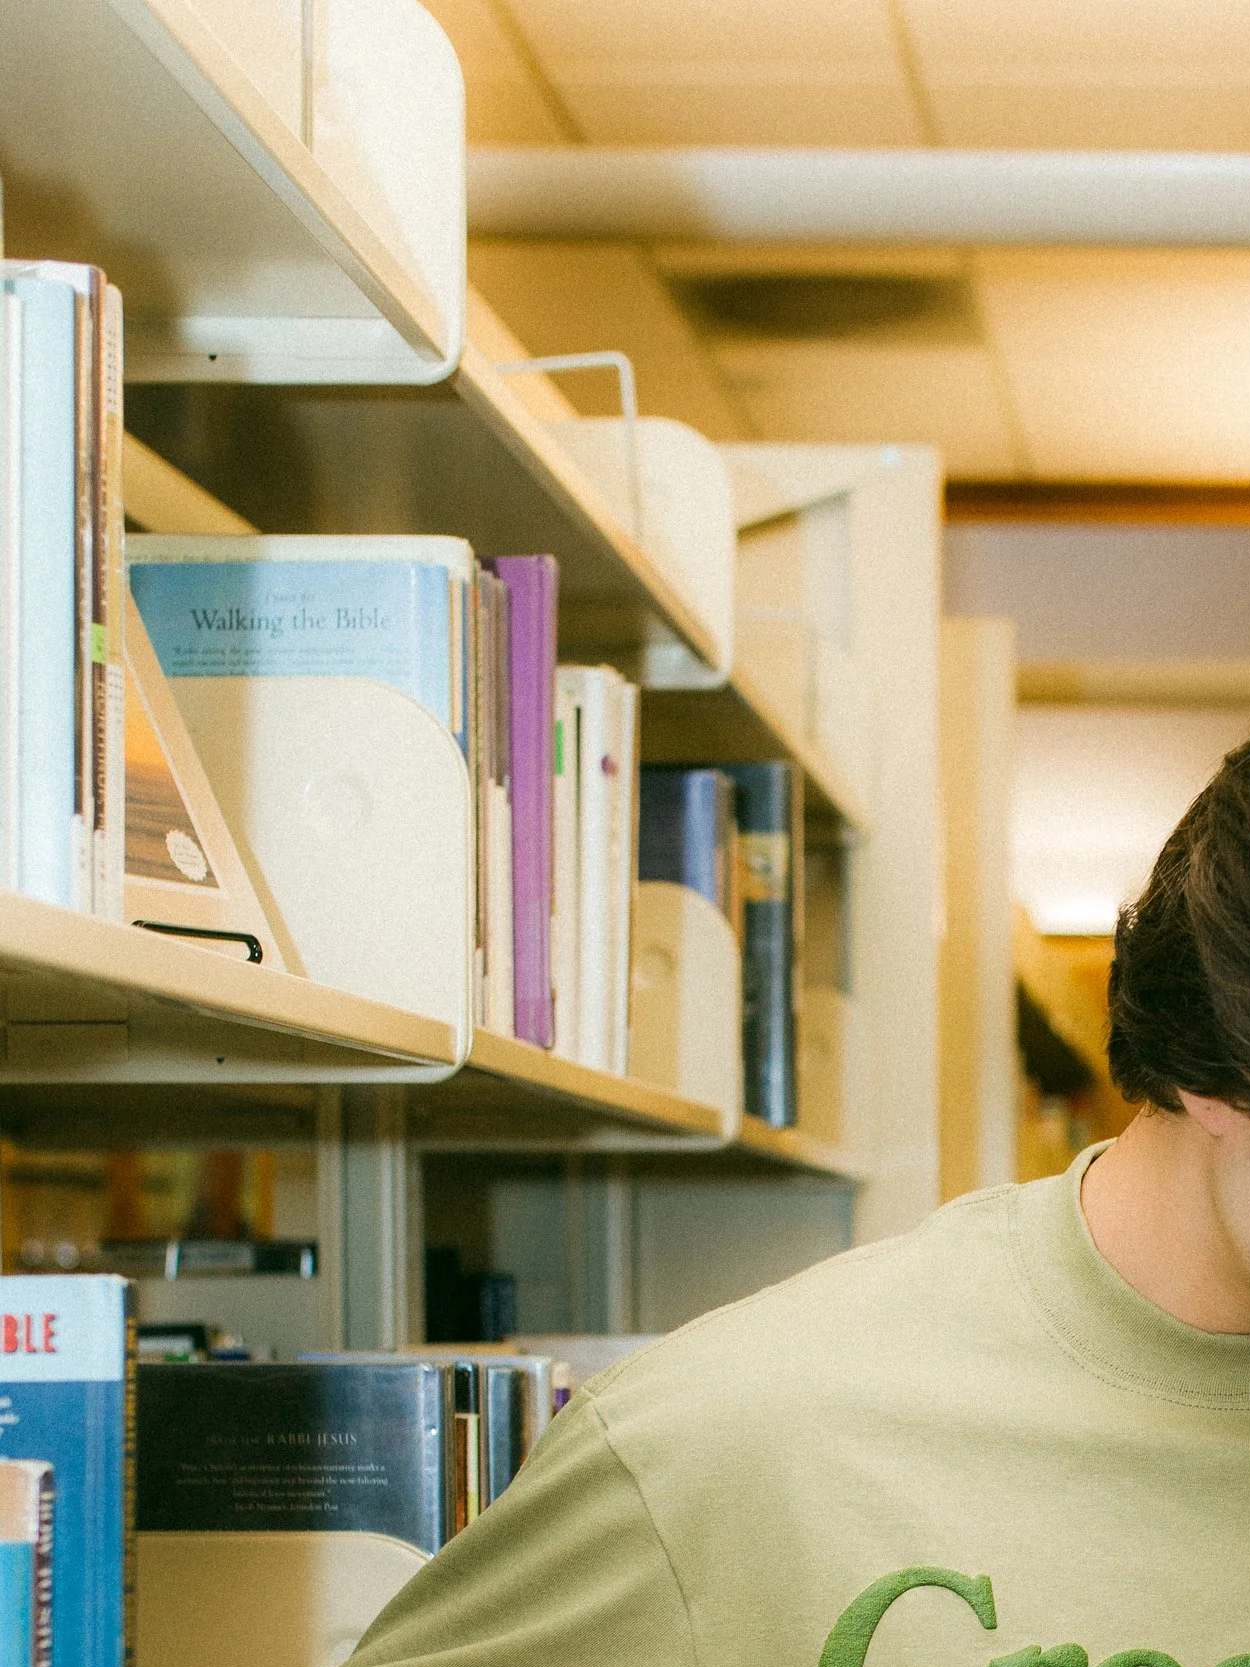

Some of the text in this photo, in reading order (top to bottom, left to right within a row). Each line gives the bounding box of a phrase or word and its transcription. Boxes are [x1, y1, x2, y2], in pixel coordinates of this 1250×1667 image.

[190, 606, 391, 639] Walking the Bible
[266, 1432, 312, 1446] RABBI
[316, 1432, 358, 1447] JESUS
